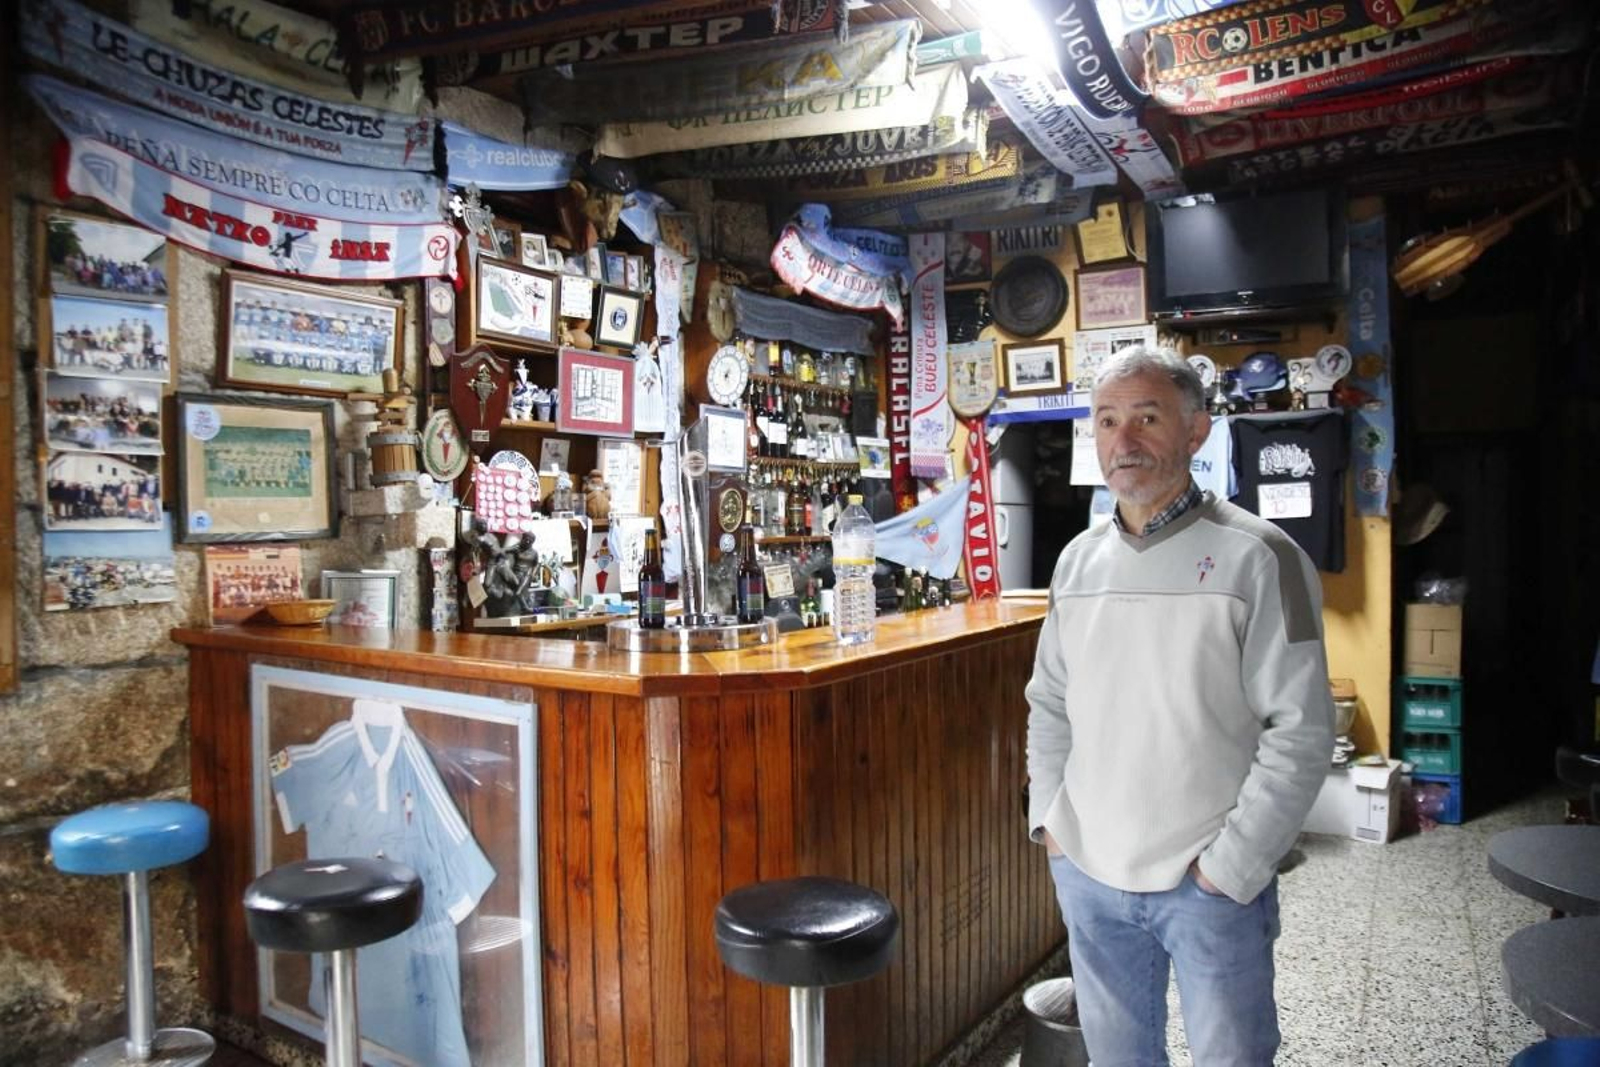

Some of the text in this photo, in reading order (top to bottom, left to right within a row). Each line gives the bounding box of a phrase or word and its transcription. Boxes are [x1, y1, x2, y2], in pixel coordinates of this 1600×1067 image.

[1055, 2, 1100, 77] VIGO
[1170, 29, 1221, 67] RC
[1247, 4, 1347, 49] LENS
[272, 94, 387, 141] CELESTES
[106, 131, 390, 212] PEÑA SEMPRE CO CELTA
[922, 284, 937, 348] CELESTE
